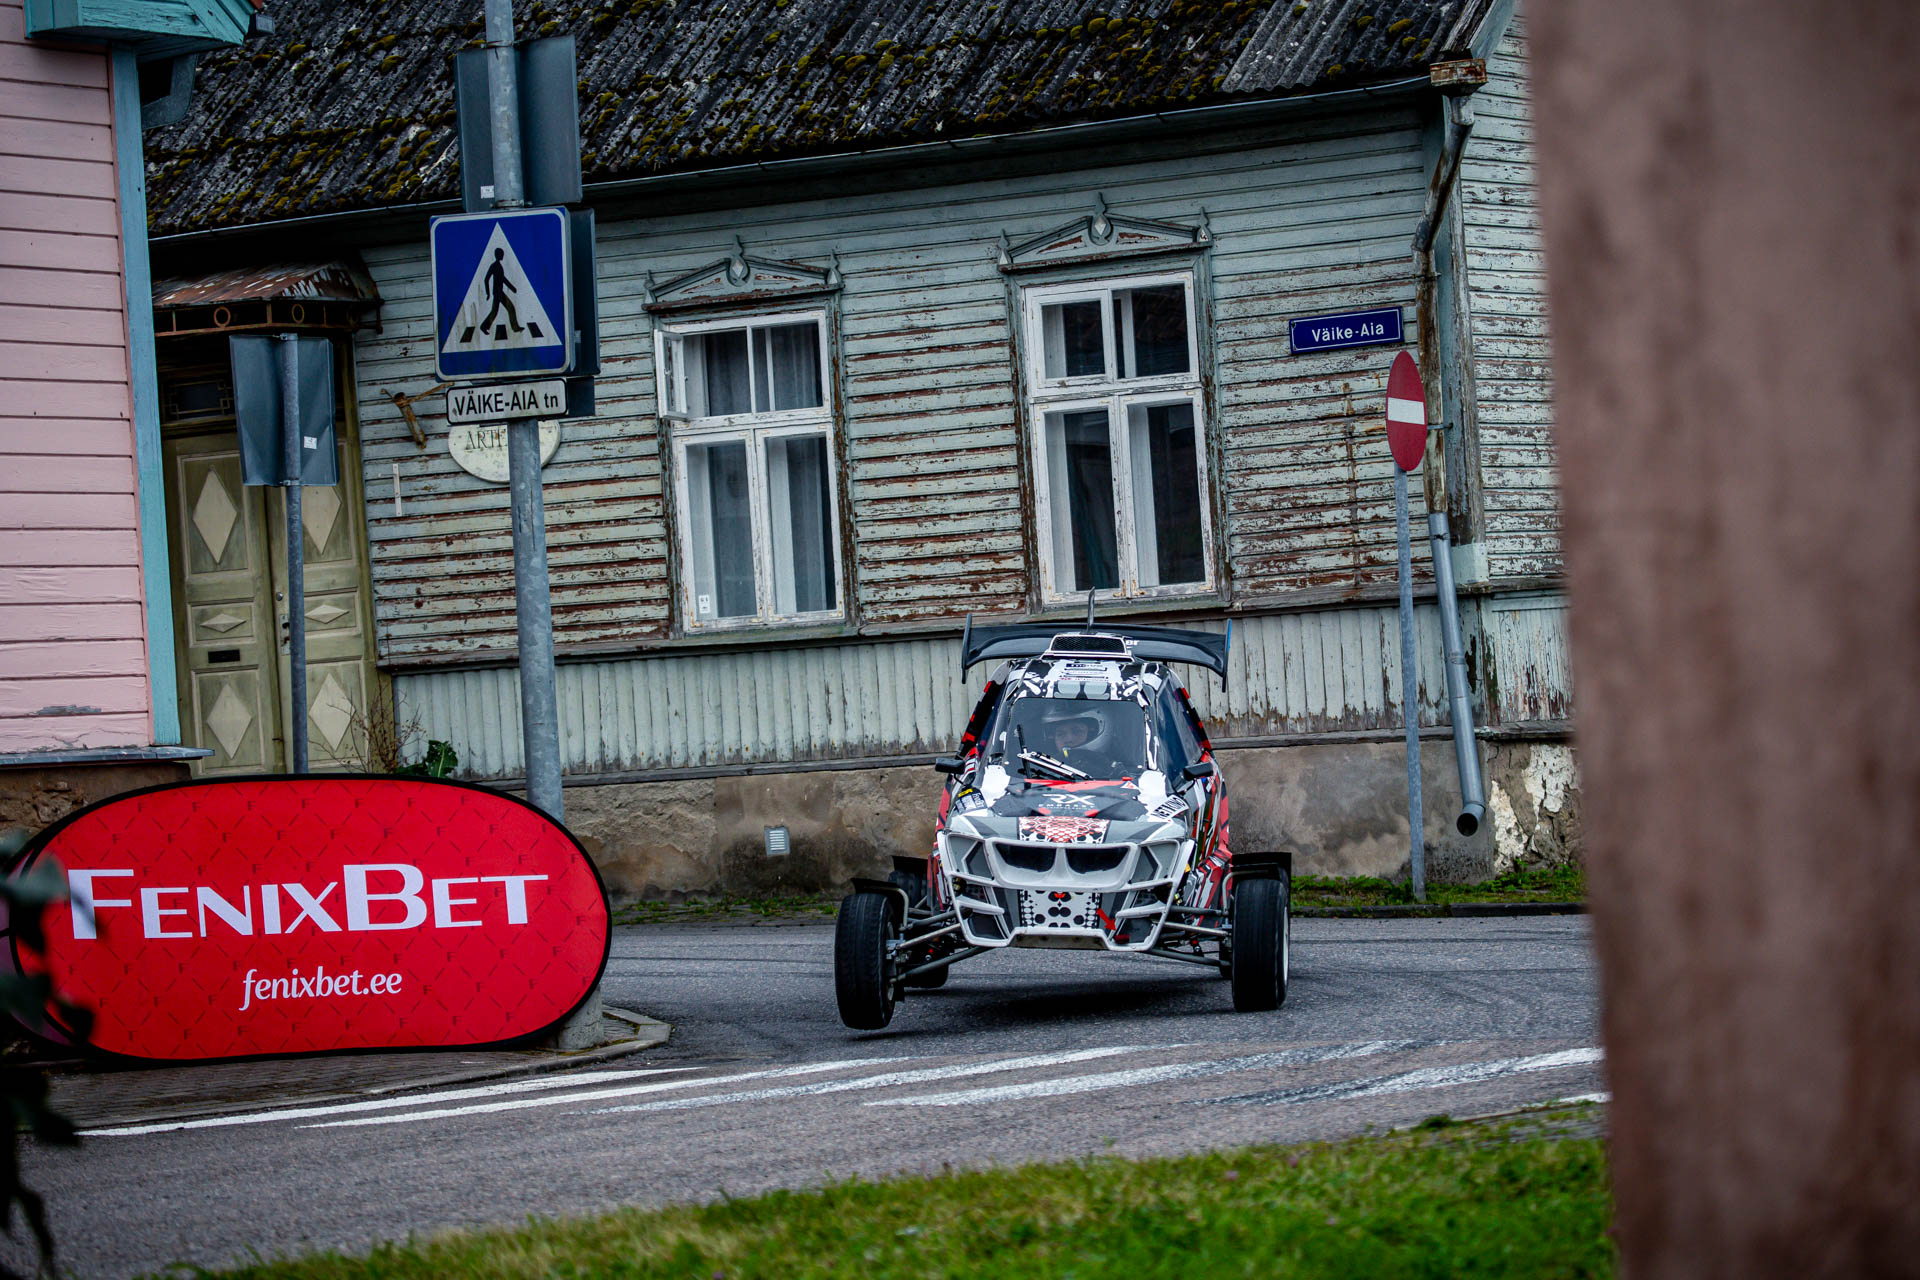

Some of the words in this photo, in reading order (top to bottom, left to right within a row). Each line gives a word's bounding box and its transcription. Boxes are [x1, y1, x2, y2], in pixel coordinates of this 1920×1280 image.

[1311, 322, 1385, 343] Väike-Aia
[454, 389, 539, 416] VÄIKE-AIA
[543, 392, 559, 409] tn
[1042, 793, 1097, 806] RX
[238, 966, 403, 1012] fenixbet.ee
